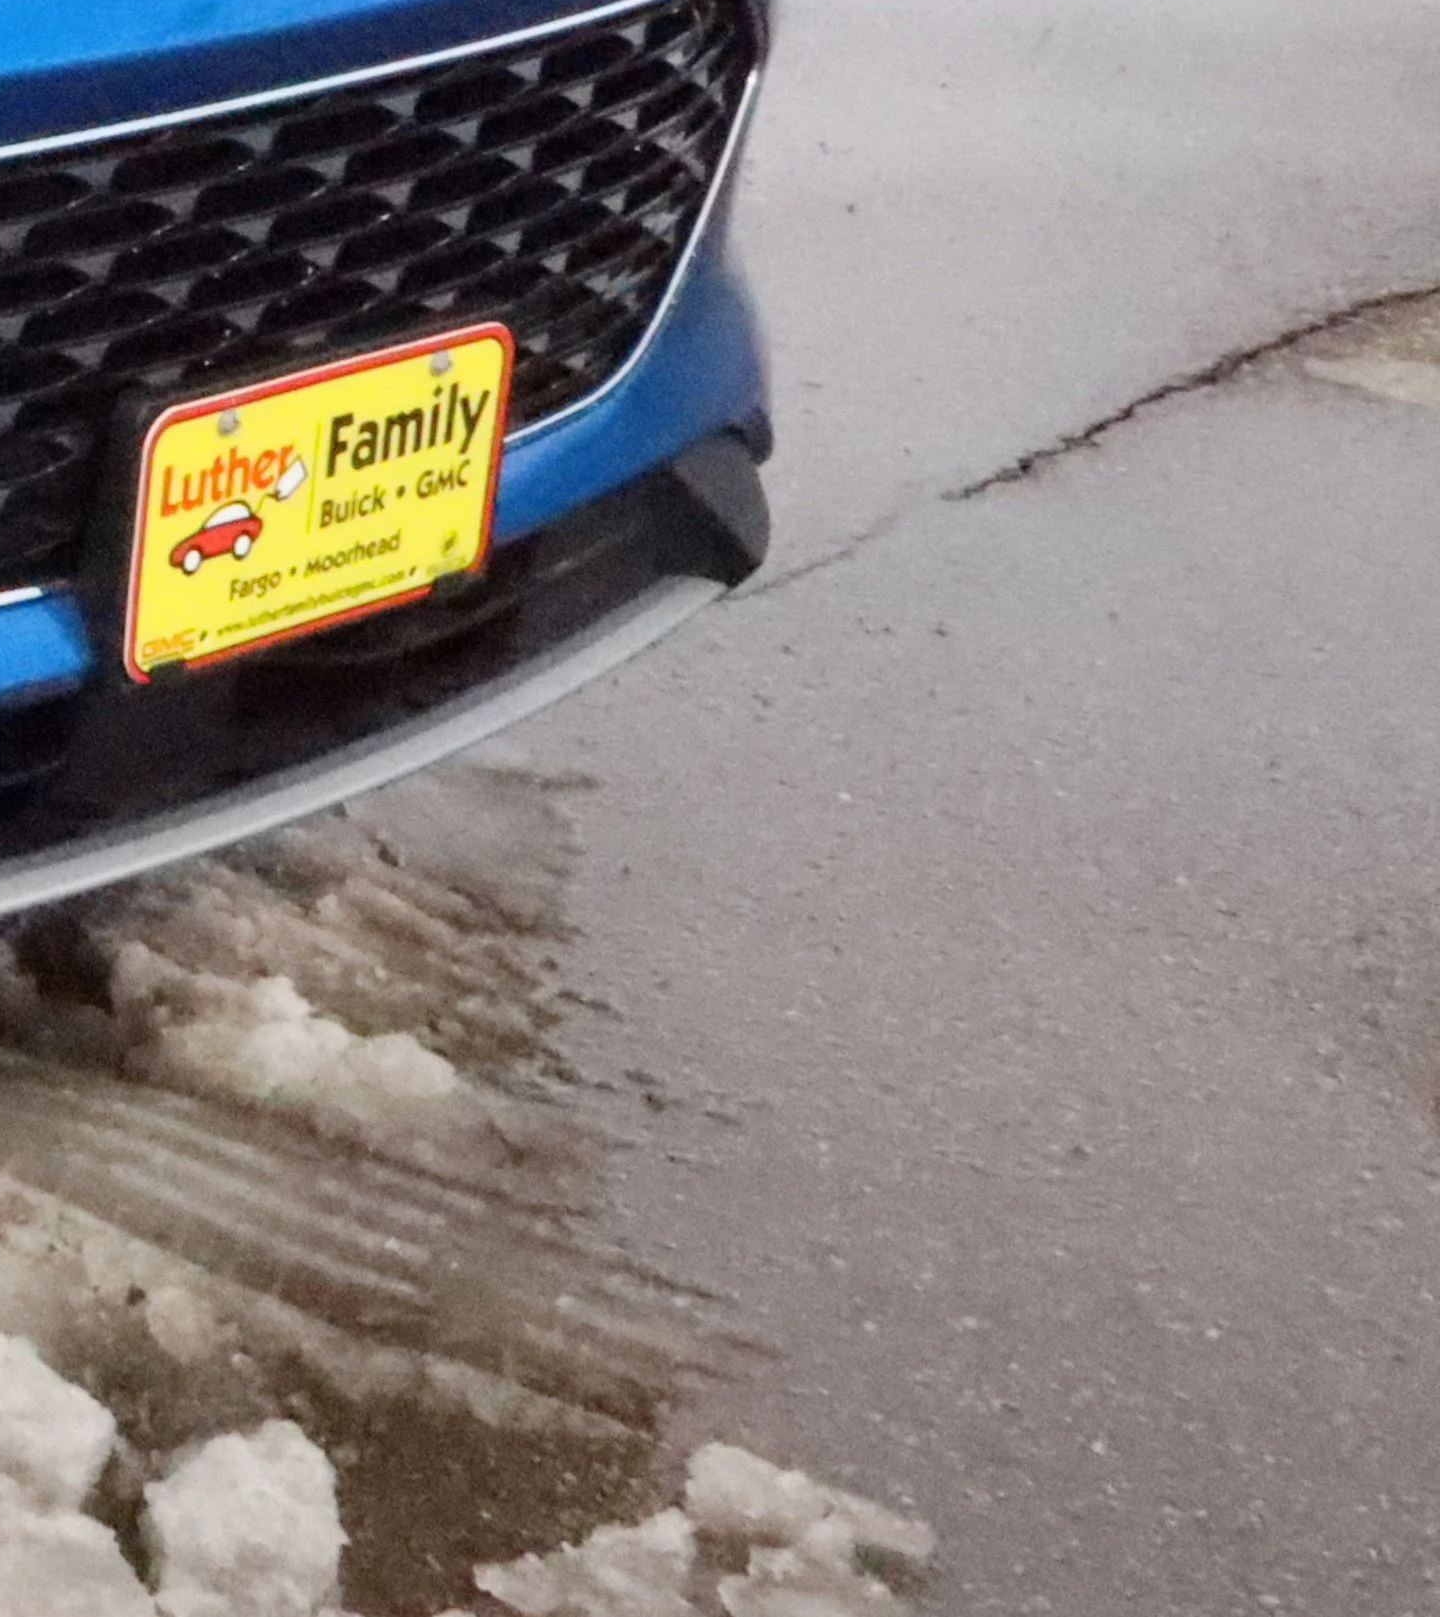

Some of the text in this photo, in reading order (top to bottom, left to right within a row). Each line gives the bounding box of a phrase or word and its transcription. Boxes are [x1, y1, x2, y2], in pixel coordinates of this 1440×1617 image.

[326, 383, 490, 478] Family
[160, 444, 296, 517] Luther
[318, 460, 471, 529] Buick GMC
[229, 570, 282, 602] Fargo
[303, 529, 400, 578] Moorhead
